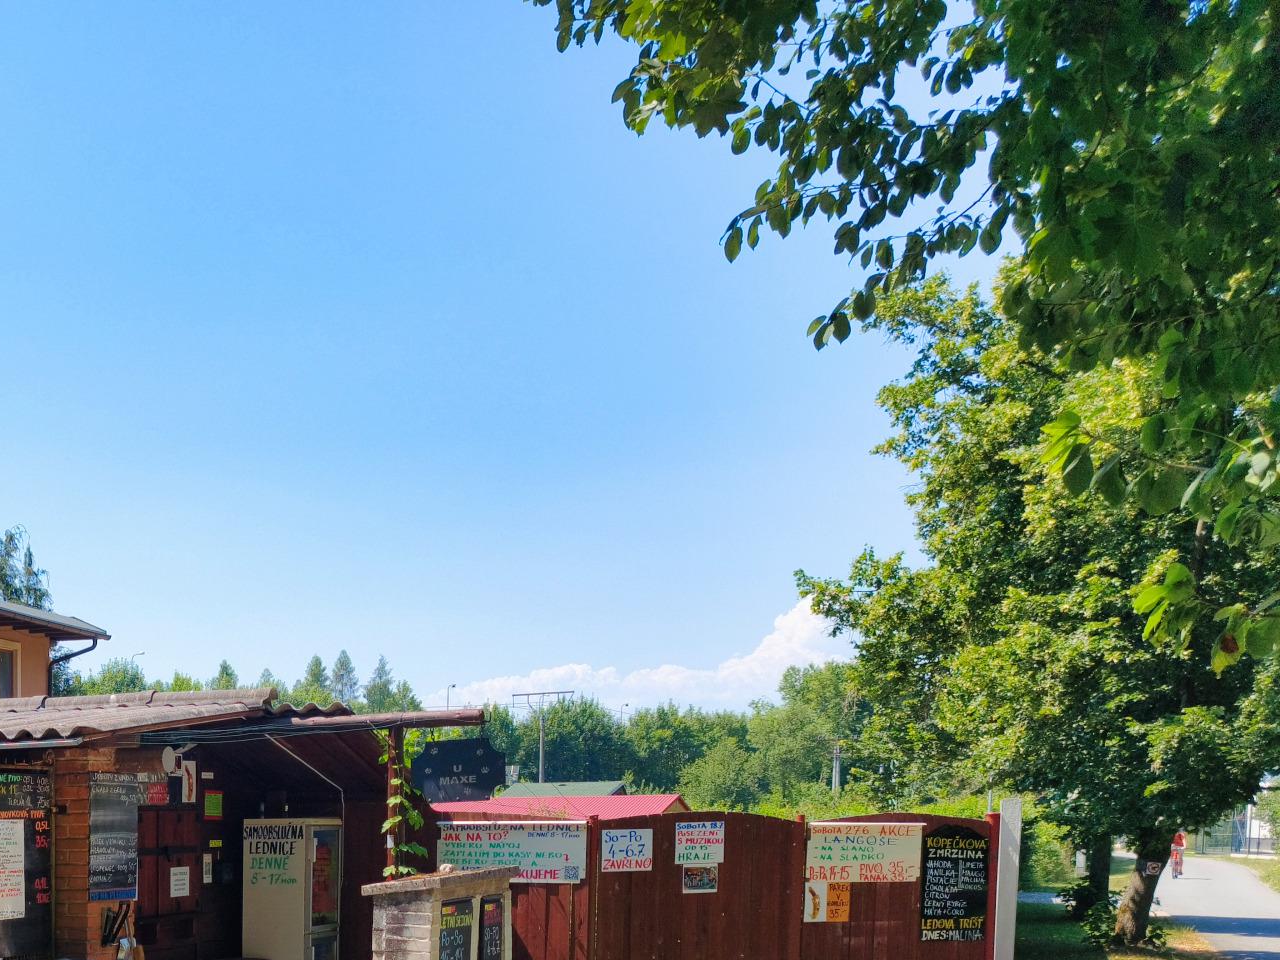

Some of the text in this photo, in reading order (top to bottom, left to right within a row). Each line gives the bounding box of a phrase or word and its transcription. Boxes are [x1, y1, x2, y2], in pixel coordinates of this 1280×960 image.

[453, 764, 462, 772] U
[439, 775, 477, 785] MAXE
[442, 832, 462, 842] JAK
[466, 832, 482, 842] NA
[487, 830, 509, 841] TO?
[879, 825, 917, 836] AKCE
[249, 840, 297, 855] LEDNICE
[928, 848, 984, 859] ZMRZLINA
[860, 862, 883, 873] PIVO
